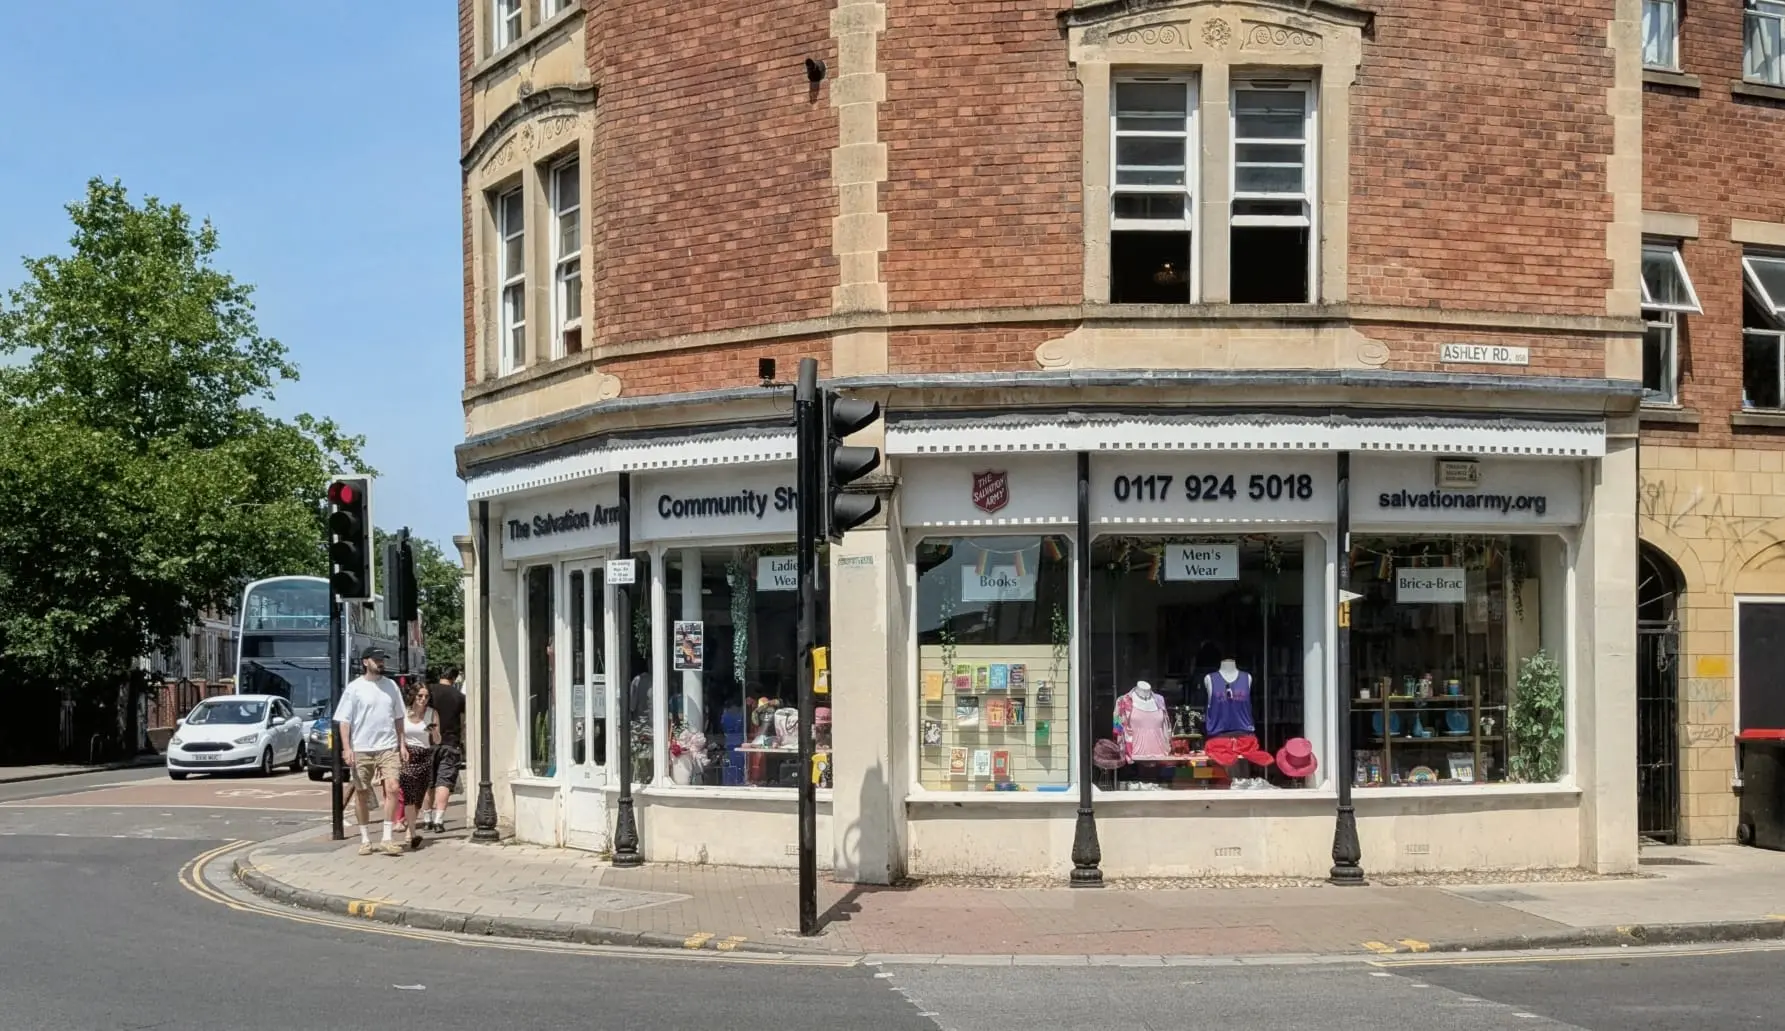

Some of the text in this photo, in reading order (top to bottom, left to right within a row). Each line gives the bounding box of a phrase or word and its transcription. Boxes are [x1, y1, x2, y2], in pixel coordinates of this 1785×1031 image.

[1443, 345, 1488, 360] ASHLEY
[1492, 347, 1512, 361] RD.
[977, 473, 993, 488] THE
[1114, 474, 1313, 501] 0117 924 5018
[973, 479, 1005, 503] SALVATION
[985, 488, 1005, 509] ARMY
[658, 486, 798, 520] Community Sh
[1379, 489, 1547, 516] salvationarmy.org
[508, 504, 620, 540] The Salvation Arm
[1181, 549, 1221, 561] Men's
[772, 559, 800, 572] Ladie
[1185, 564, 1218, 576] Wear
[774, 575, 797, 586] Wea
[980, 575, 1017, 587] Books
[1400, 577, 1464, 589] Bric-a-Brac
